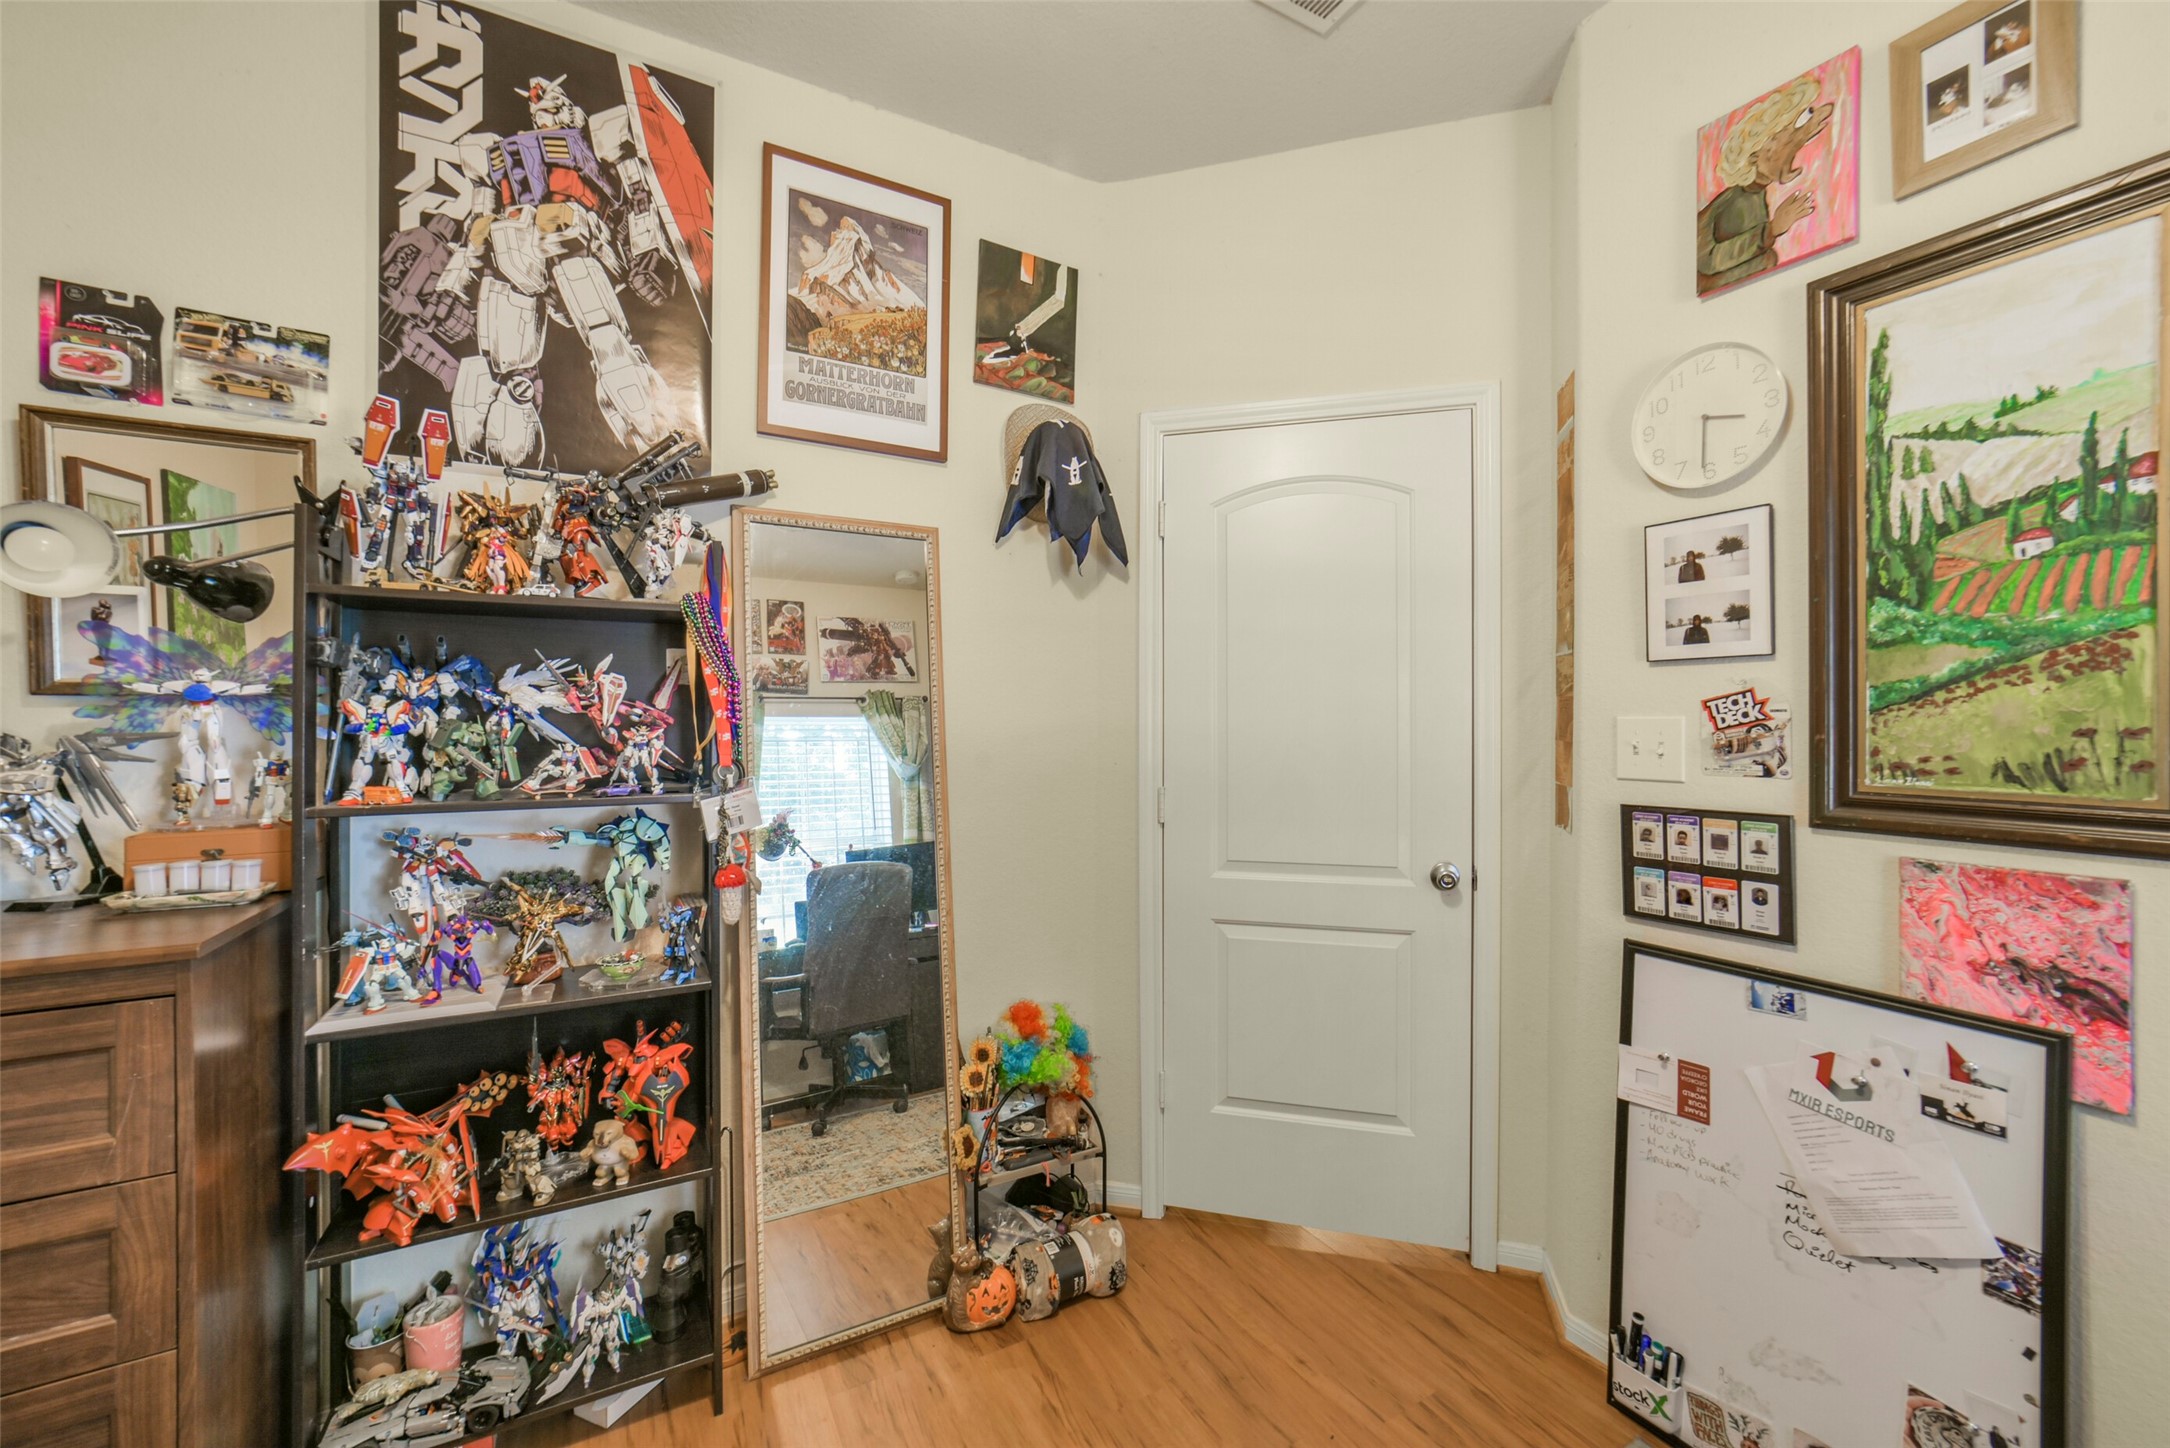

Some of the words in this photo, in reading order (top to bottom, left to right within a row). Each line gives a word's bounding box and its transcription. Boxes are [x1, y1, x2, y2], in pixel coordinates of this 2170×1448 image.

[1696, 355, 1716, 375] 12
[1734, 352, 1740, 370] 1
[798, 355, 916, 395] MATTERHORN
[1670, 371, 1684, 392] 11
[1752, 363, 1768, 384] 2
[784, 379, 926, 423] GORNERGRATBAHN
[858, 385, 881, 395] VON
[886, 390, 907, 400] DER
[1764, 388, 1780, 408] 3
[1650, 397, 1669, 418] 10
[1642, 425, 1655, 443] 9
[1756, 419, 1772, 438] 4
[1652, 448, 1665, 466] 8
[1733, 445, 1749, 465] 5
[1674, 460, 1688, 480] 7
[1703, 461, 1717, 480] 6
[1706, 691, 1755, 717] TECH
[1715, 703, 1768, 729] DECK
[1682, 1089, 1707, 1102] WORLD
[1688, 1099, 1708, 1110] YOUR
[1825, 1104, 1895, 1143] ESPORTS
